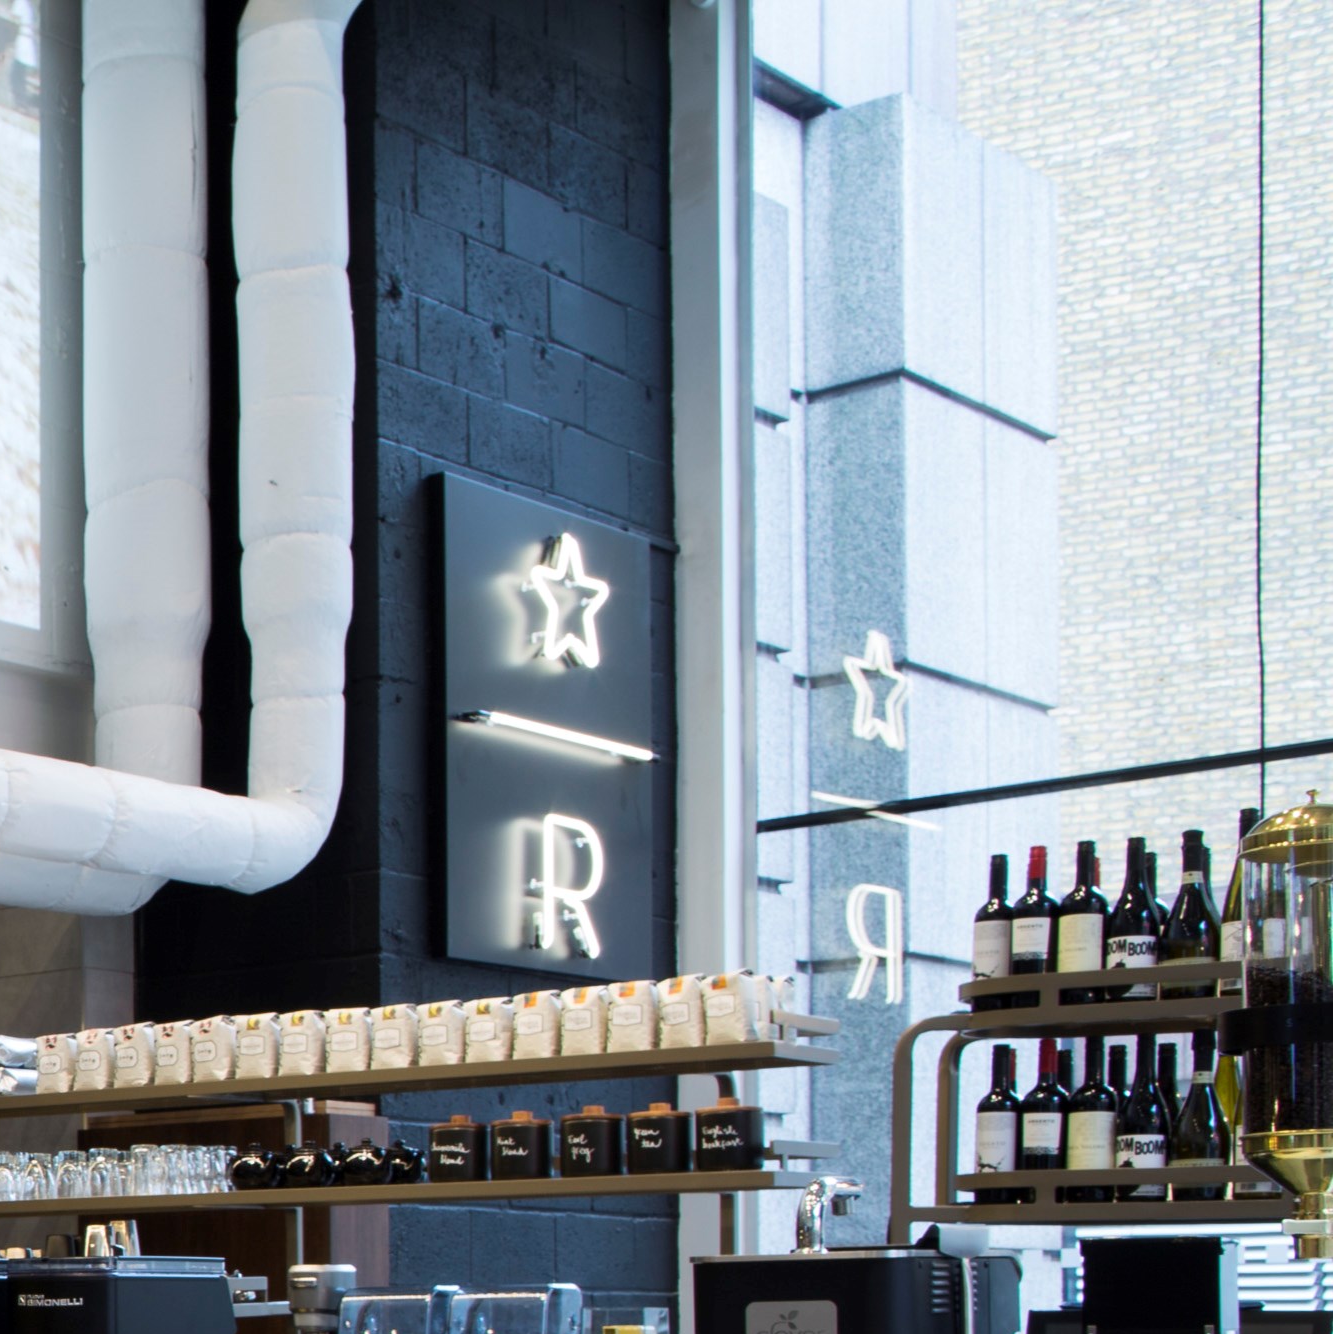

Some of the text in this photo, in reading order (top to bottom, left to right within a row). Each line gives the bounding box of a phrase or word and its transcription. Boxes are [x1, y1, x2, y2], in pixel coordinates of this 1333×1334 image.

[540, 813, 604, 960] R
[1127, 942, 1157, 956] BOOM
[1134, 1138, 1165, 1155] BOOM
